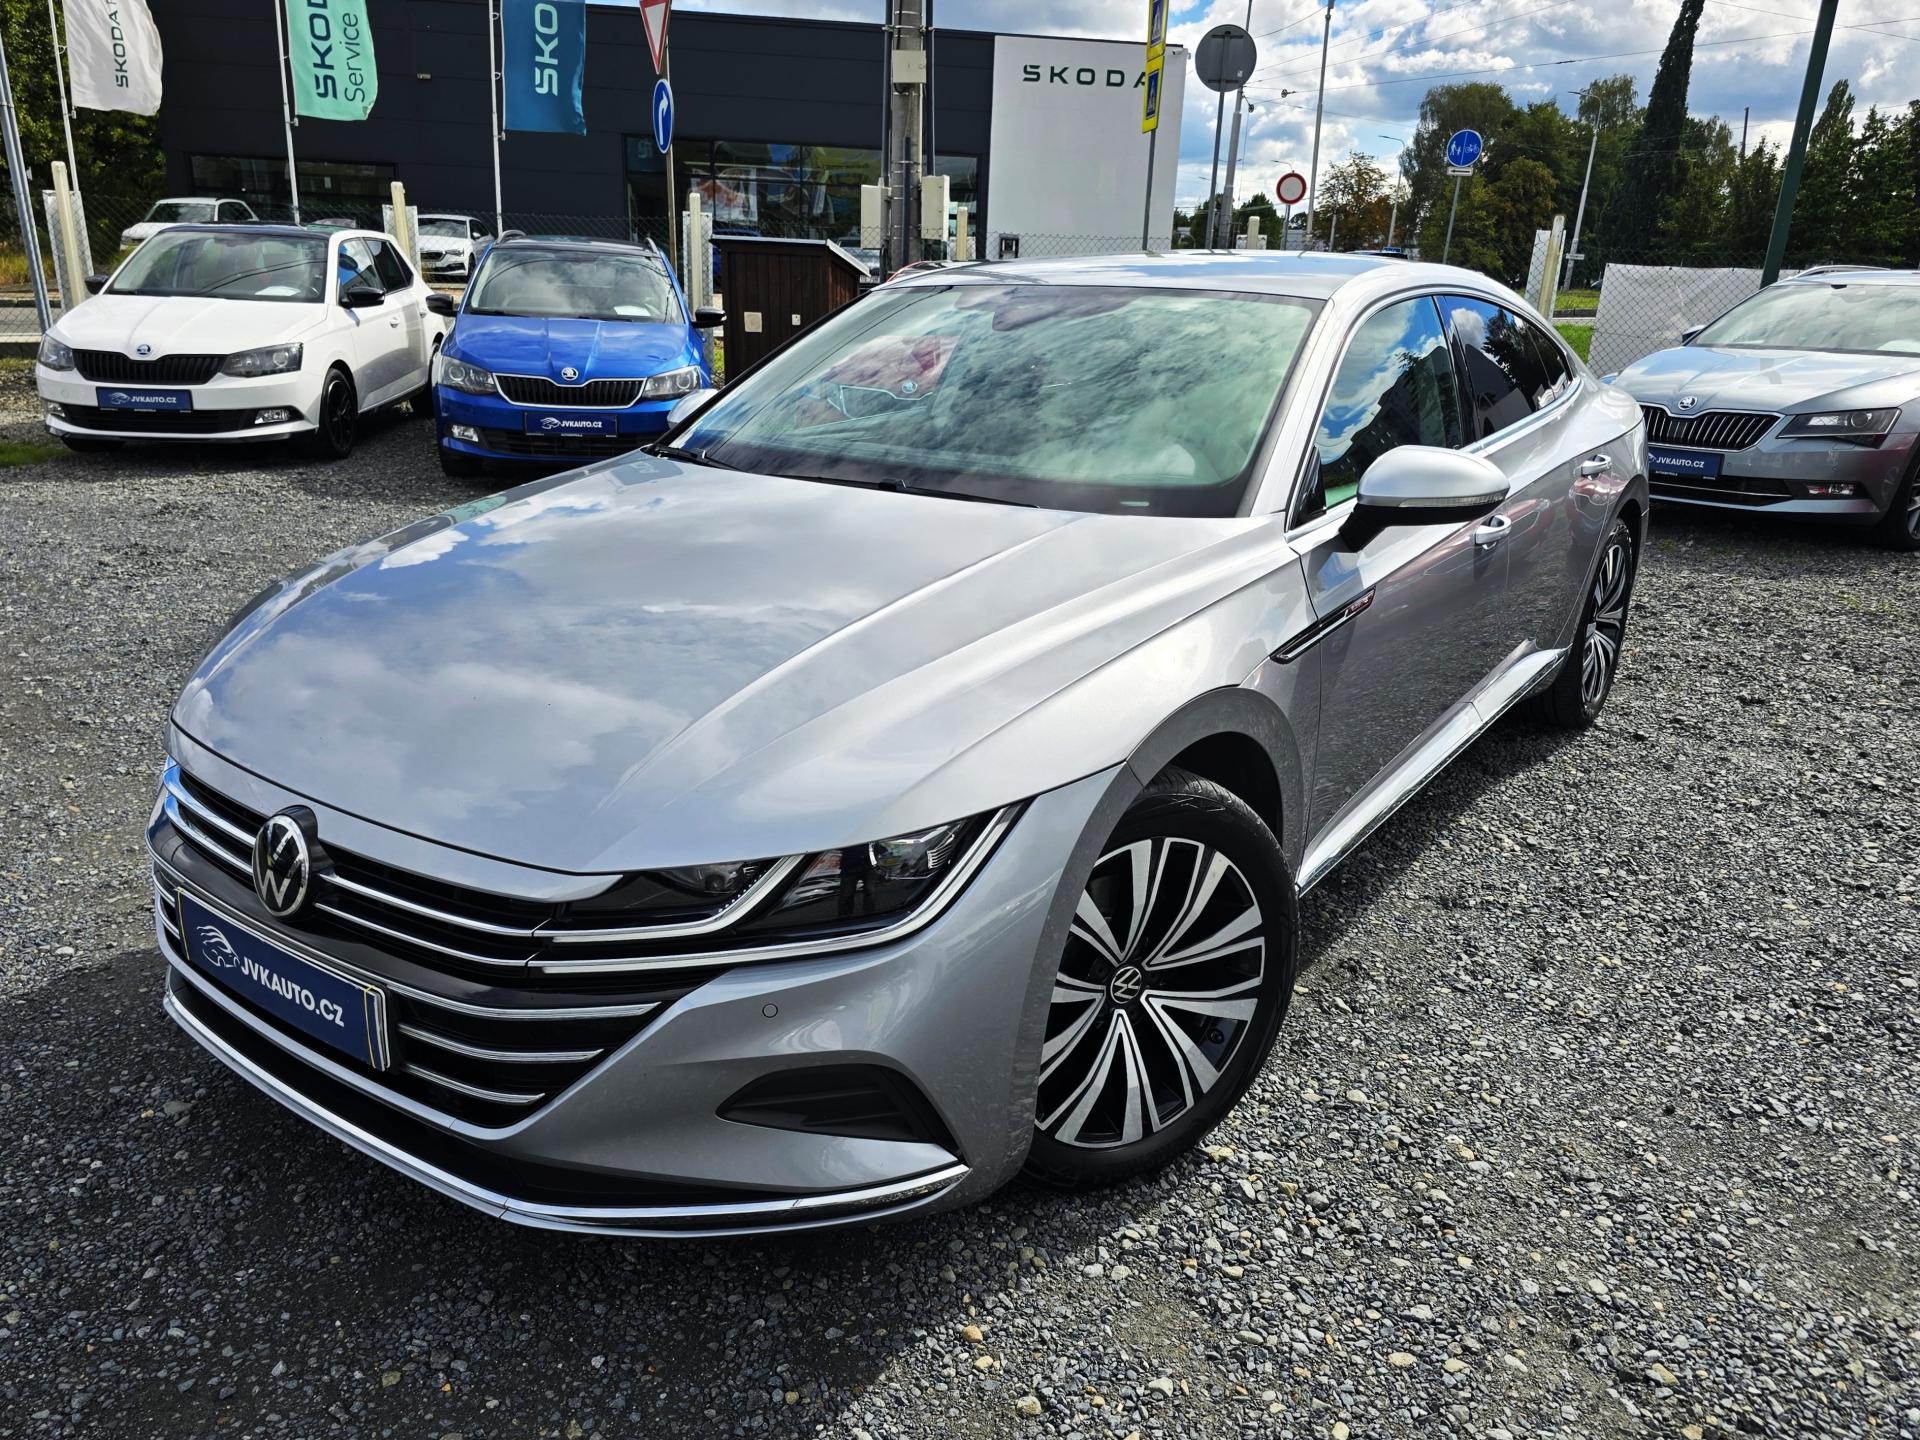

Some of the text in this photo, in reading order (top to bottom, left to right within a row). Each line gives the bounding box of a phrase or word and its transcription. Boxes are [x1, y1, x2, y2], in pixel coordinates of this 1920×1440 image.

[340, 13, 365, 102] Service
[560, 420, 602, 428] JVKAUTO.CZ
[1656, 457, 1704, 468] JVKAUTO.CZ
[241, 956, 345, 1027] JVKAUTO.CZ
